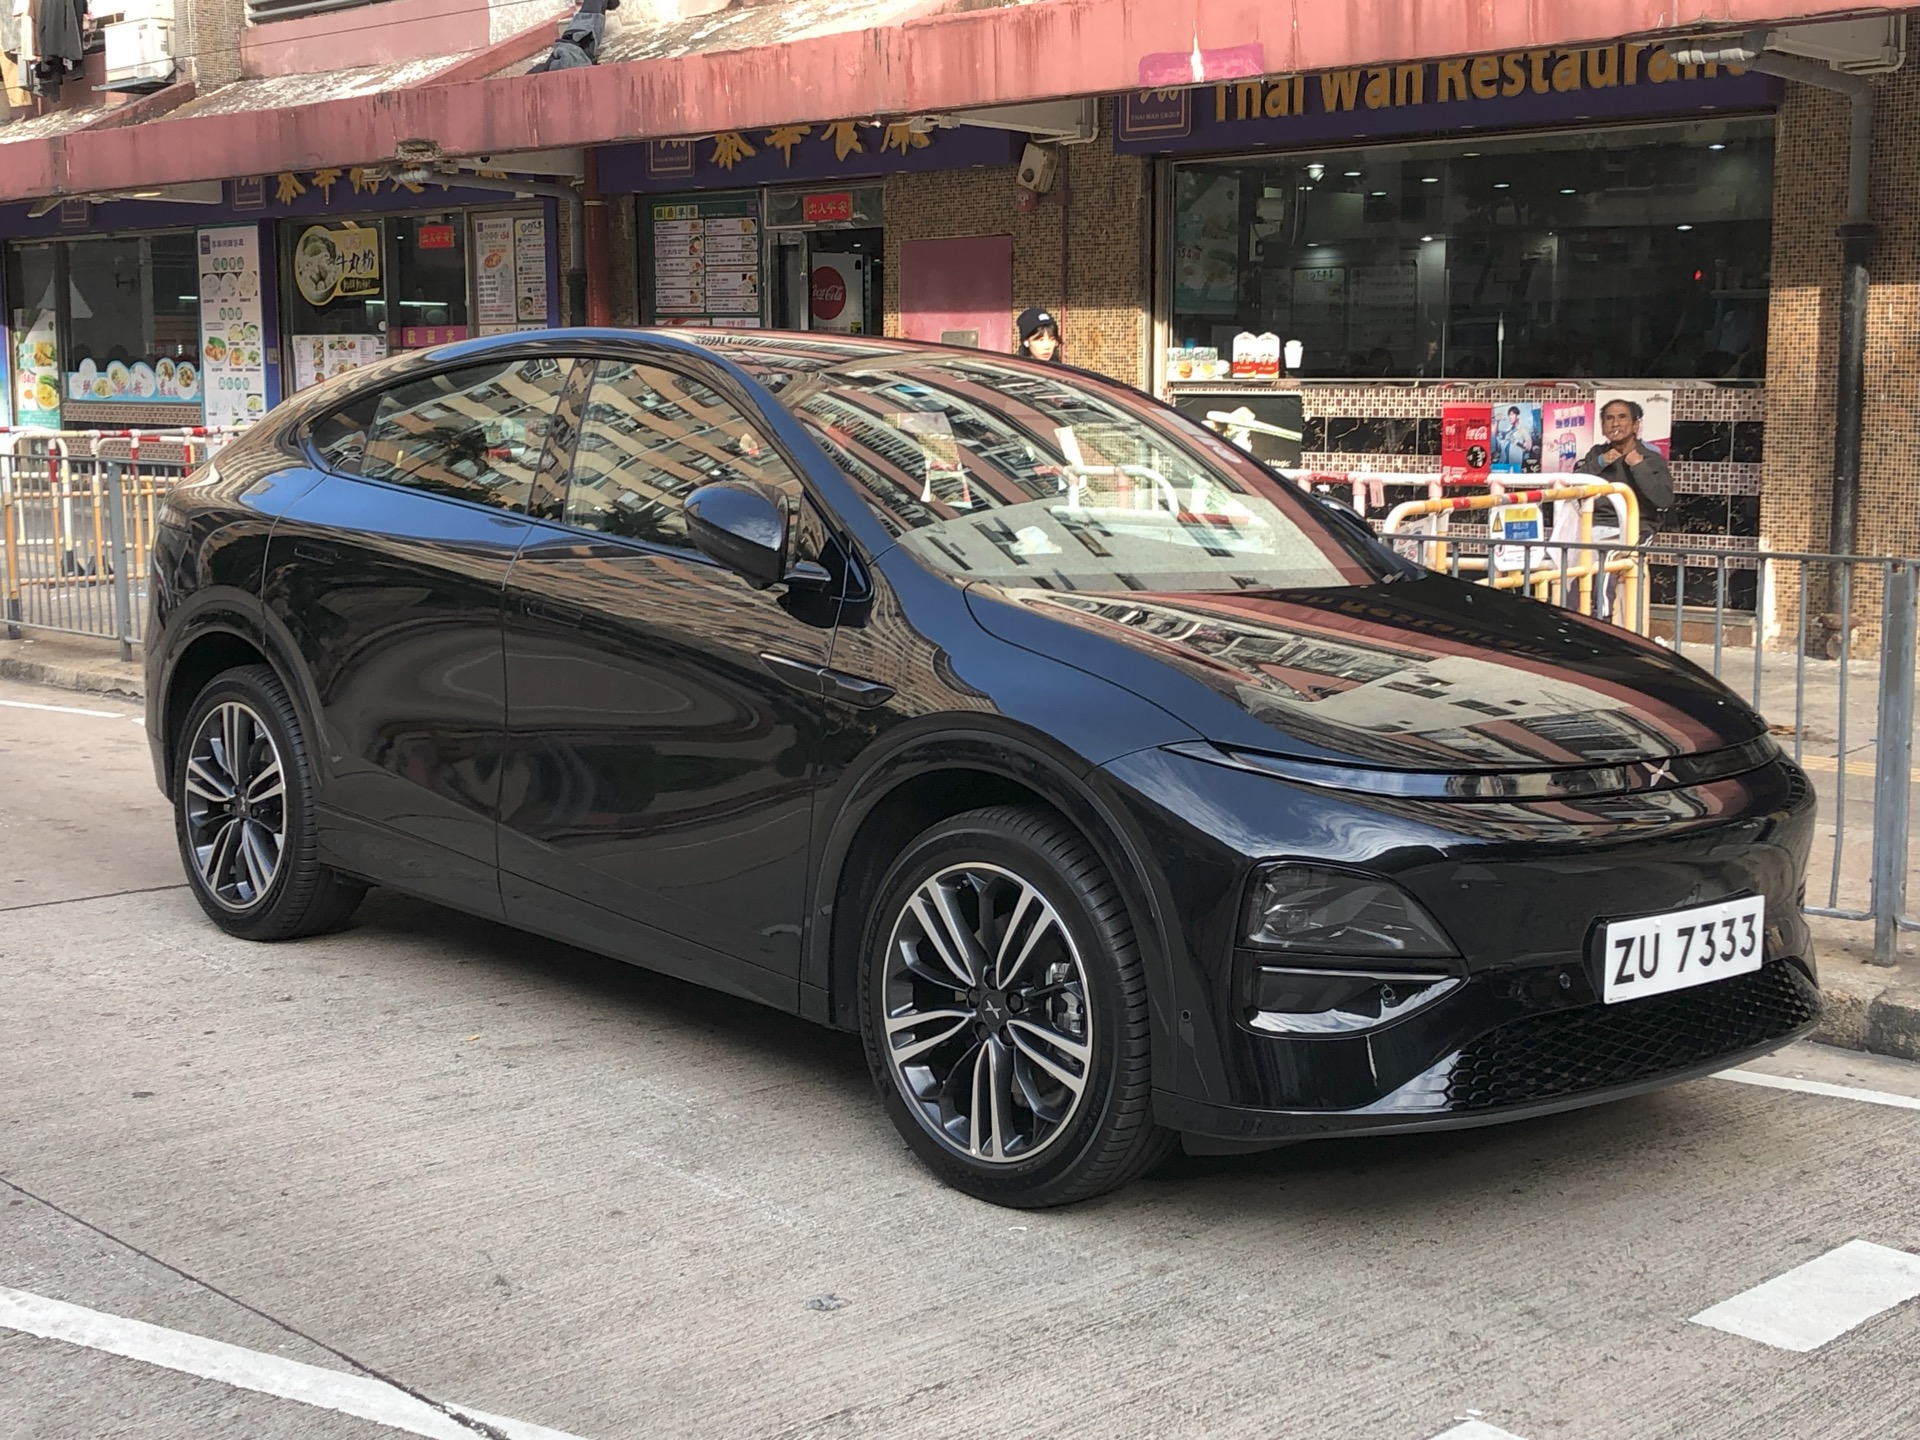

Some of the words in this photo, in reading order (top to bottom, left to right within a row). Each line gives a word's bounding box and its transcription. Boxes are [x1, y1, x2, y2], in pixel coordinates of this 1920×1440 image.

[1215, 75, 1304, 122] Thai
[1321, 63, 1424, 113] Wan
[808, 201, 848, 214] 出入平安
[1271, 459, 1292, 468] Magic
[1614, 932, 1660, 986] ZU
[1677, 913, 1756, 973] 7333
